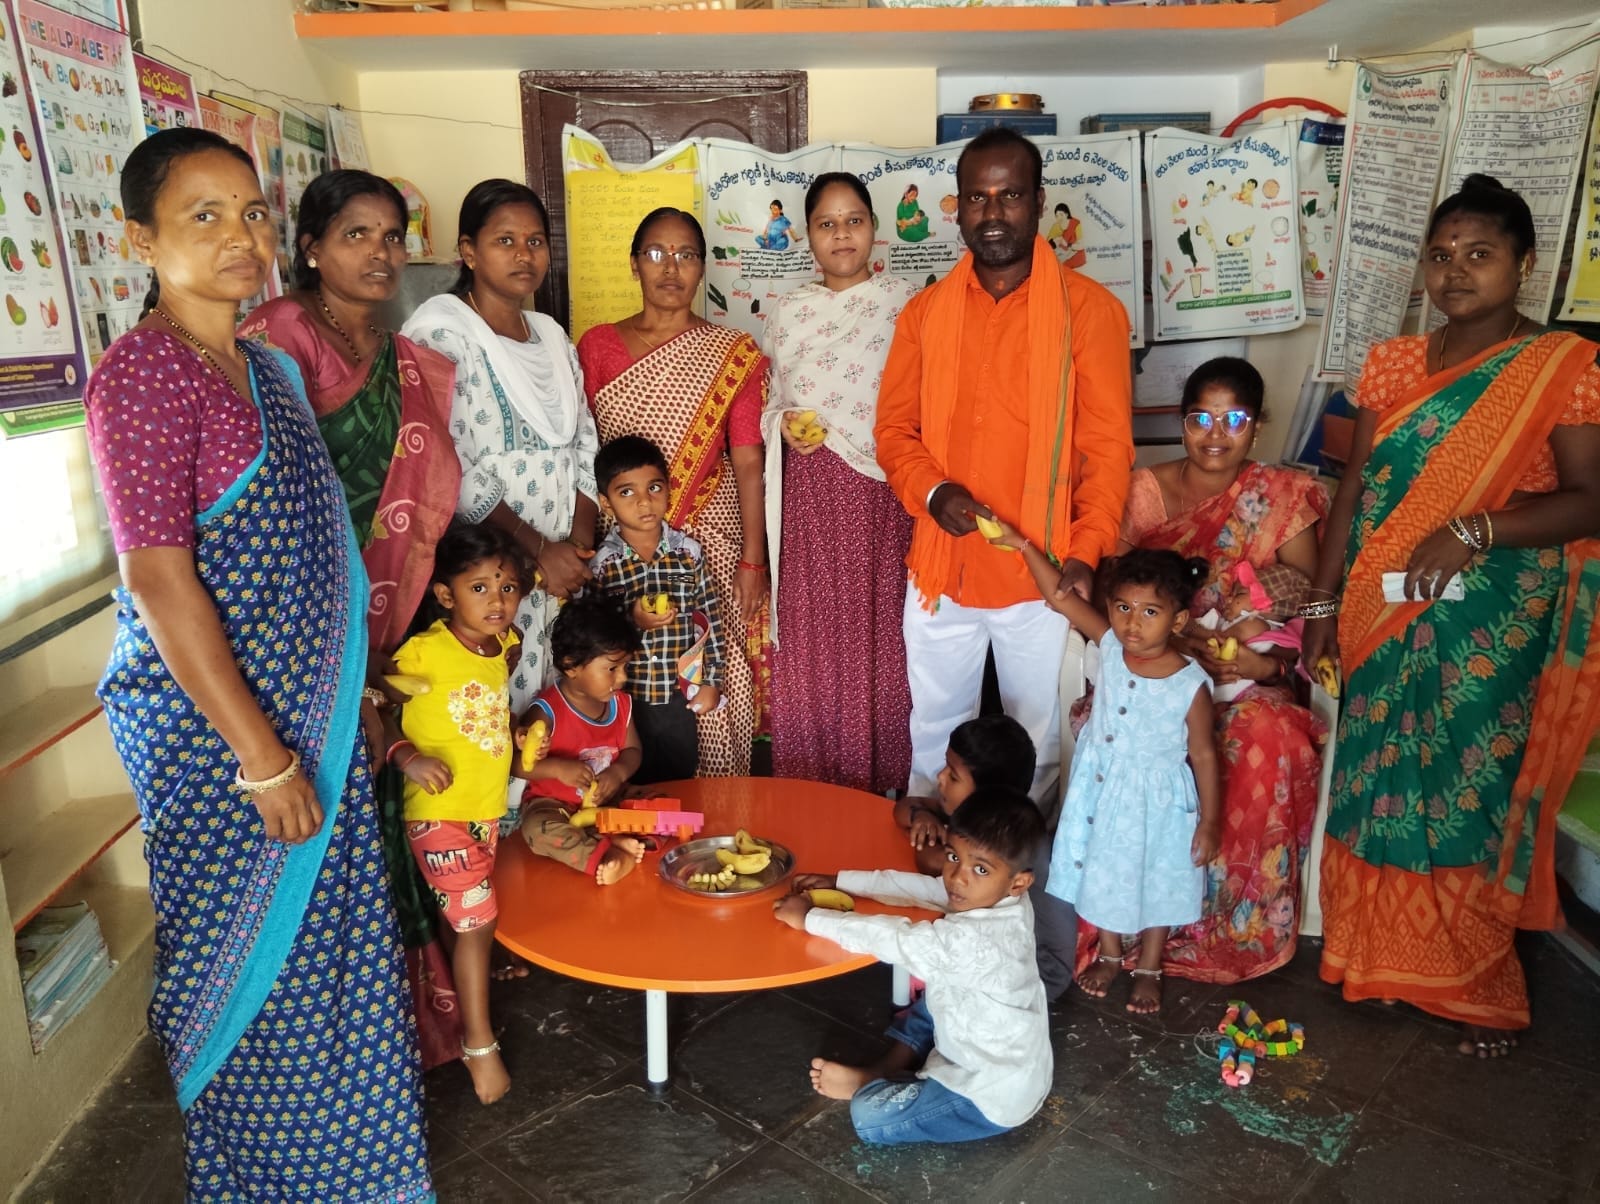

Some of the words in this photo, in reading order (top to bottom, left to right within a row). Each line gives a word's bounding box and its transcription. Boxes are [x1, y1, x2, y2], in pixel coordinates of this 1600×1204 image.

[20, 15, 46, 41] THE
[50, 26, 109, 63] ALPHABET
[1083, 152, 1090, 162] 6
